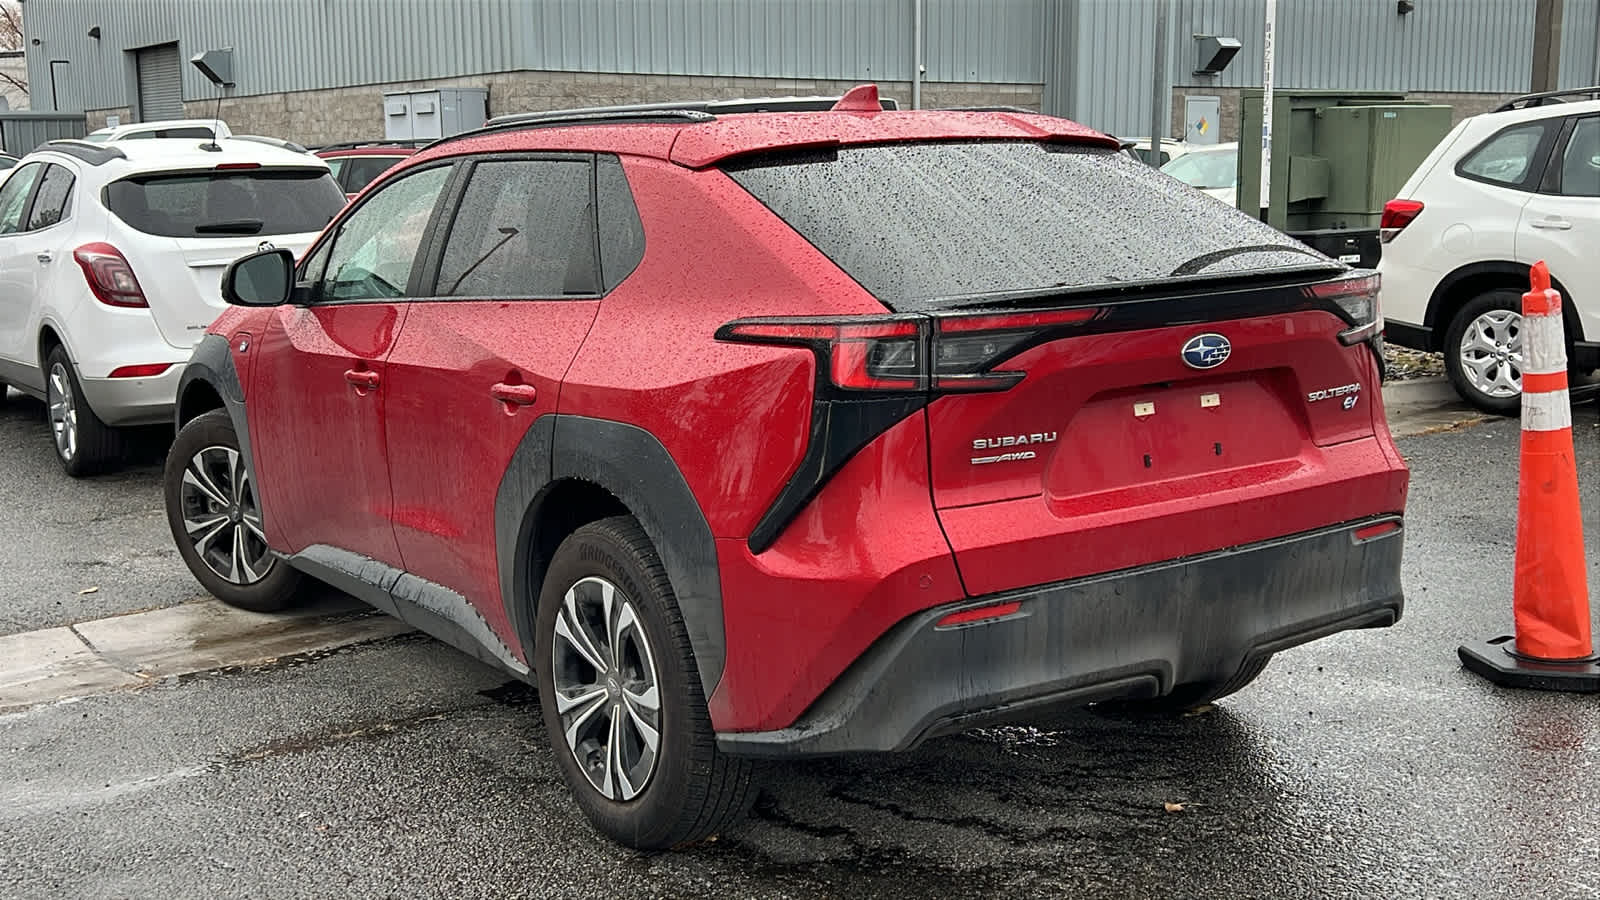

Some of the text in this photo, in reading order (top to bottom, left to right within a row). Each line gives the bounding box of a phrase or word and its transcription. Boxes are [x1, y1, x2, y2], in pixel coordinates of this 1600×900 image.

[1308, 382, 1361, 402] SOLTERRA
[973, 431, 1057, 449] SUBARU
[996, 451, 1036, 463] AWD
